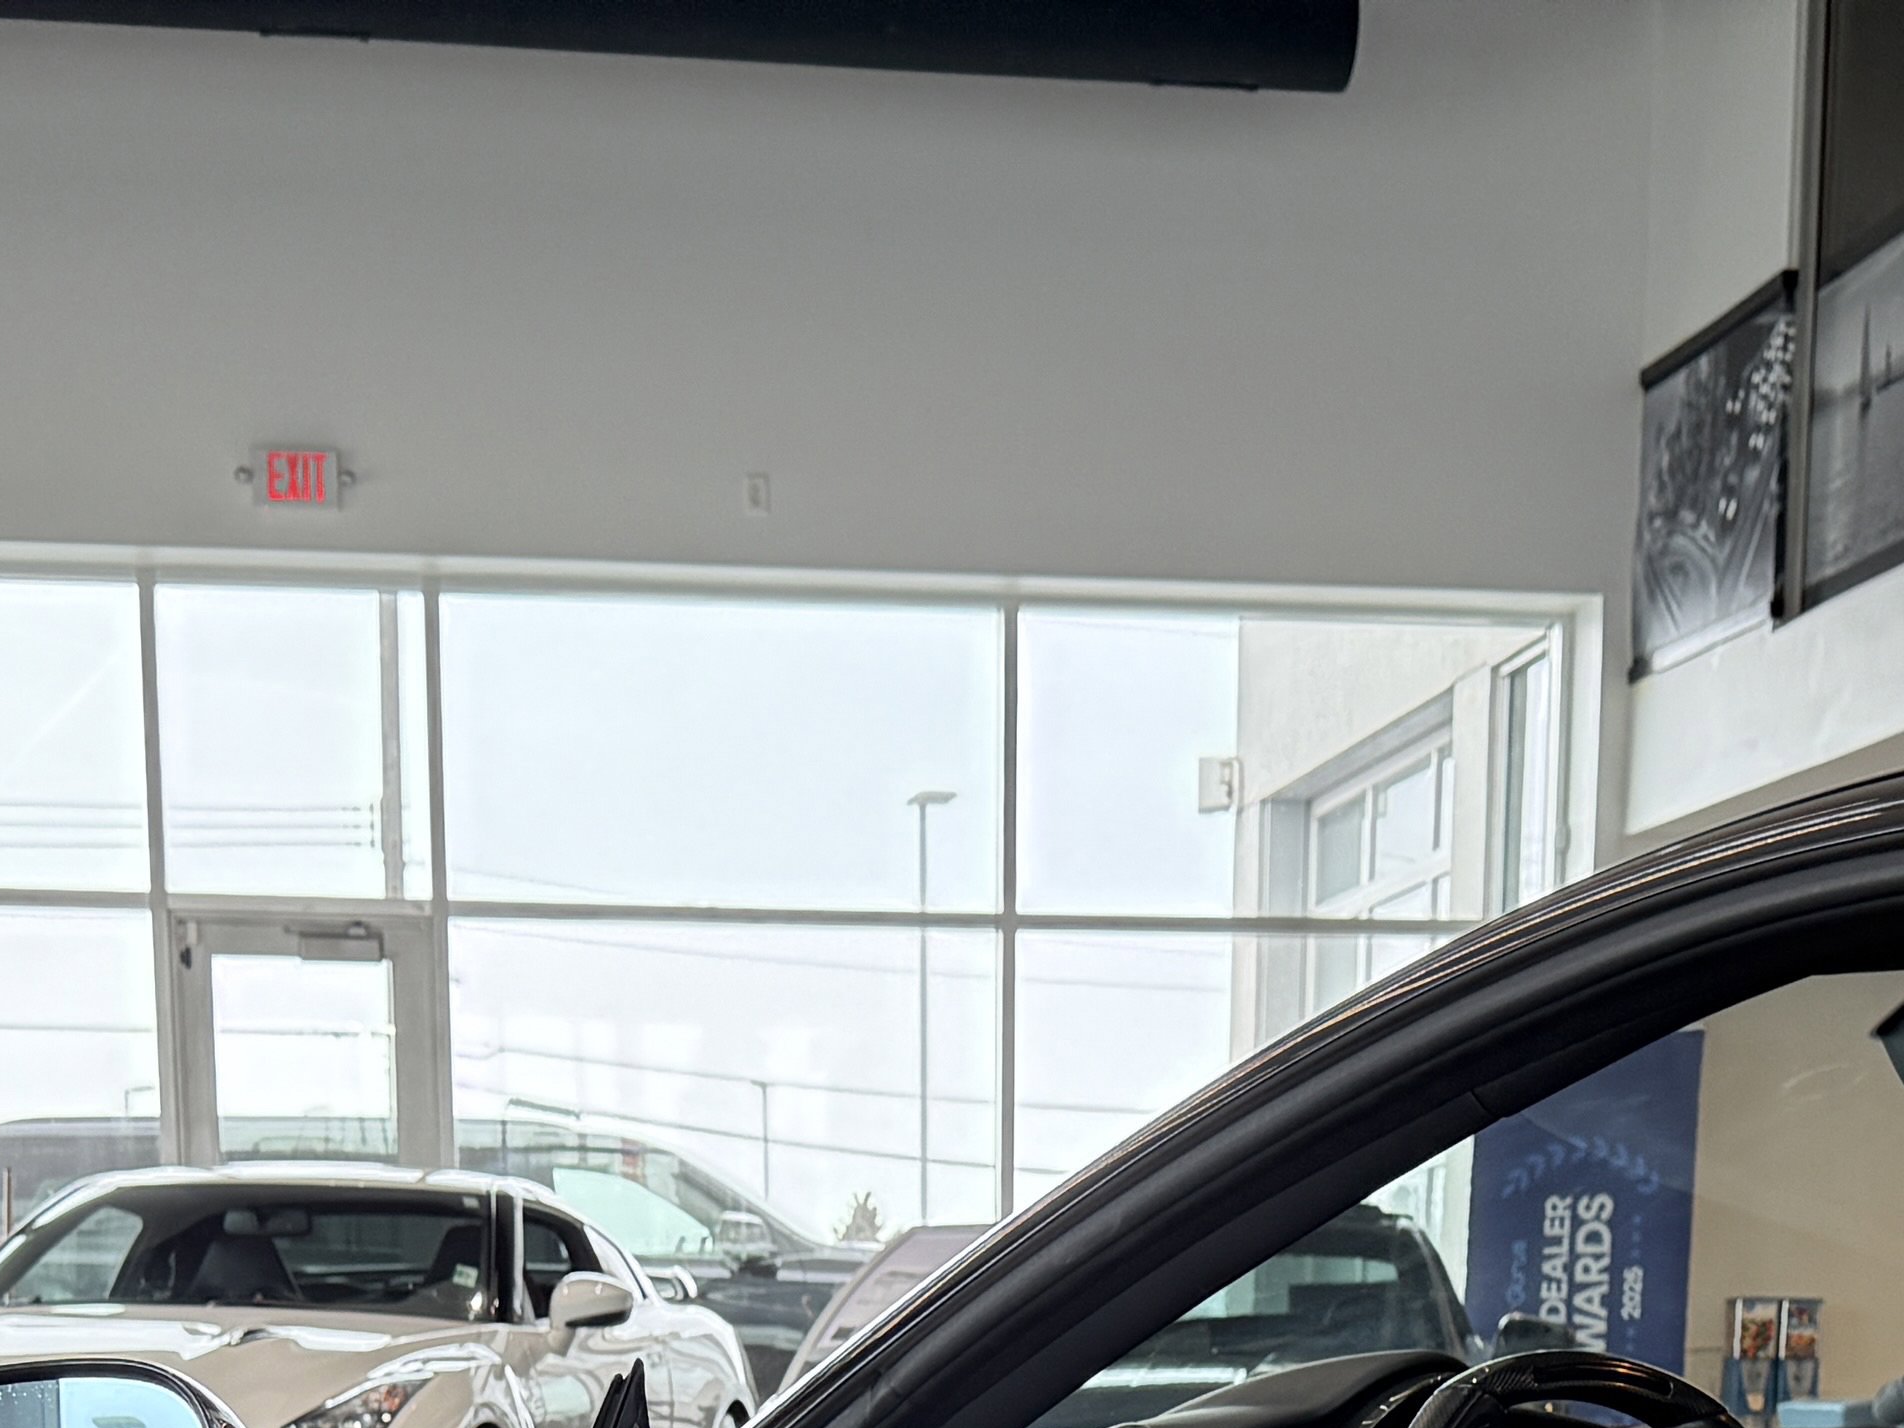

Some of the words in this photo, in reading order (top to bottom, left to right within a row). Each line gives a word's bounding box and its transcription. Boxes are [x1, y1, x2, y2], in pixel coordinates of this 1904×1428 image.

[267, 450, 328, 504] EXIT
[1538, 1195, 1573, 1325] DEALER
[1572, 1193, 1615, 1354] WARDS
[1621, 1265, 1645, 1322] 2025
